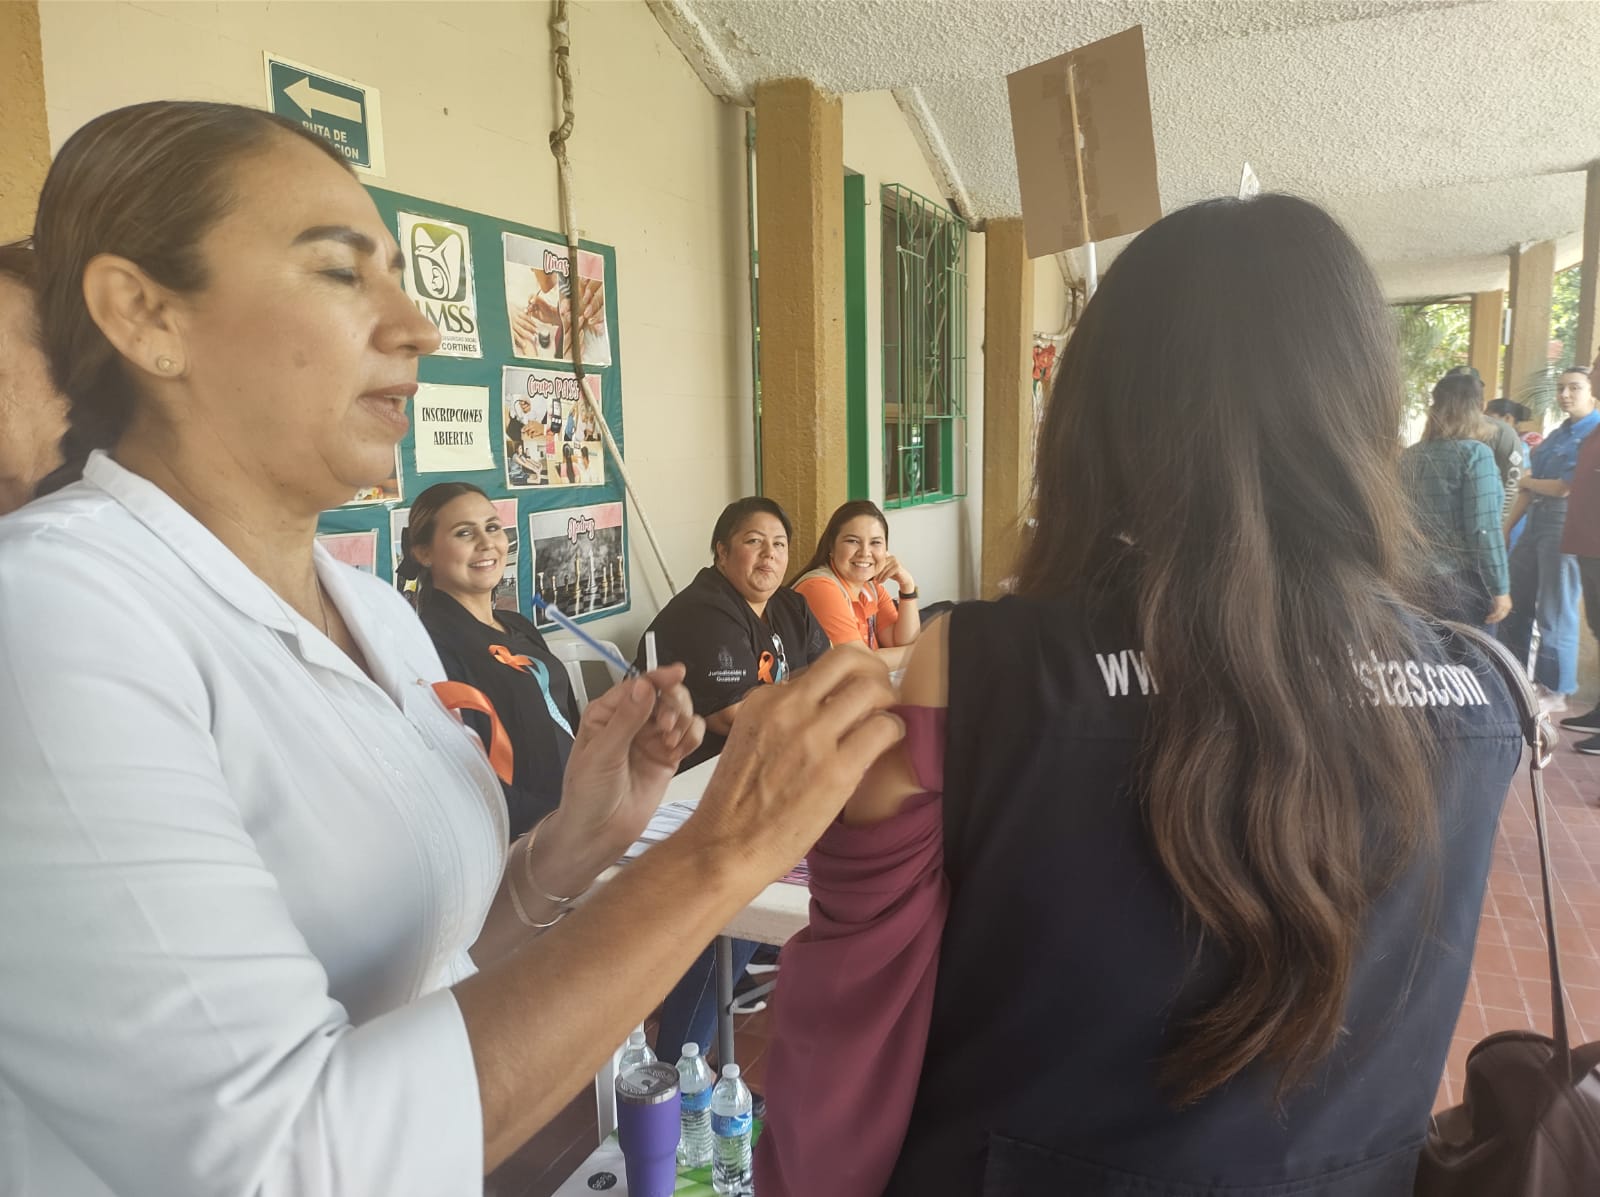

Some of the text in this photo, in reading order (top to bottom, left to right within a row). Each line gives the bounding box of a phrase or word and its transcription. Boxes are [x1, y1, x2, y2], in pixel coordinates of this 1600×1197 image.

[333, 128, 348, 143] DE
[441, 342, 477, 353] CORTINES
[528, 374, 554, 399] Grupo
[422, 407, 483, 423] INSCRIPCIONES
[433, 431, 474, 446] ABIERTAS
